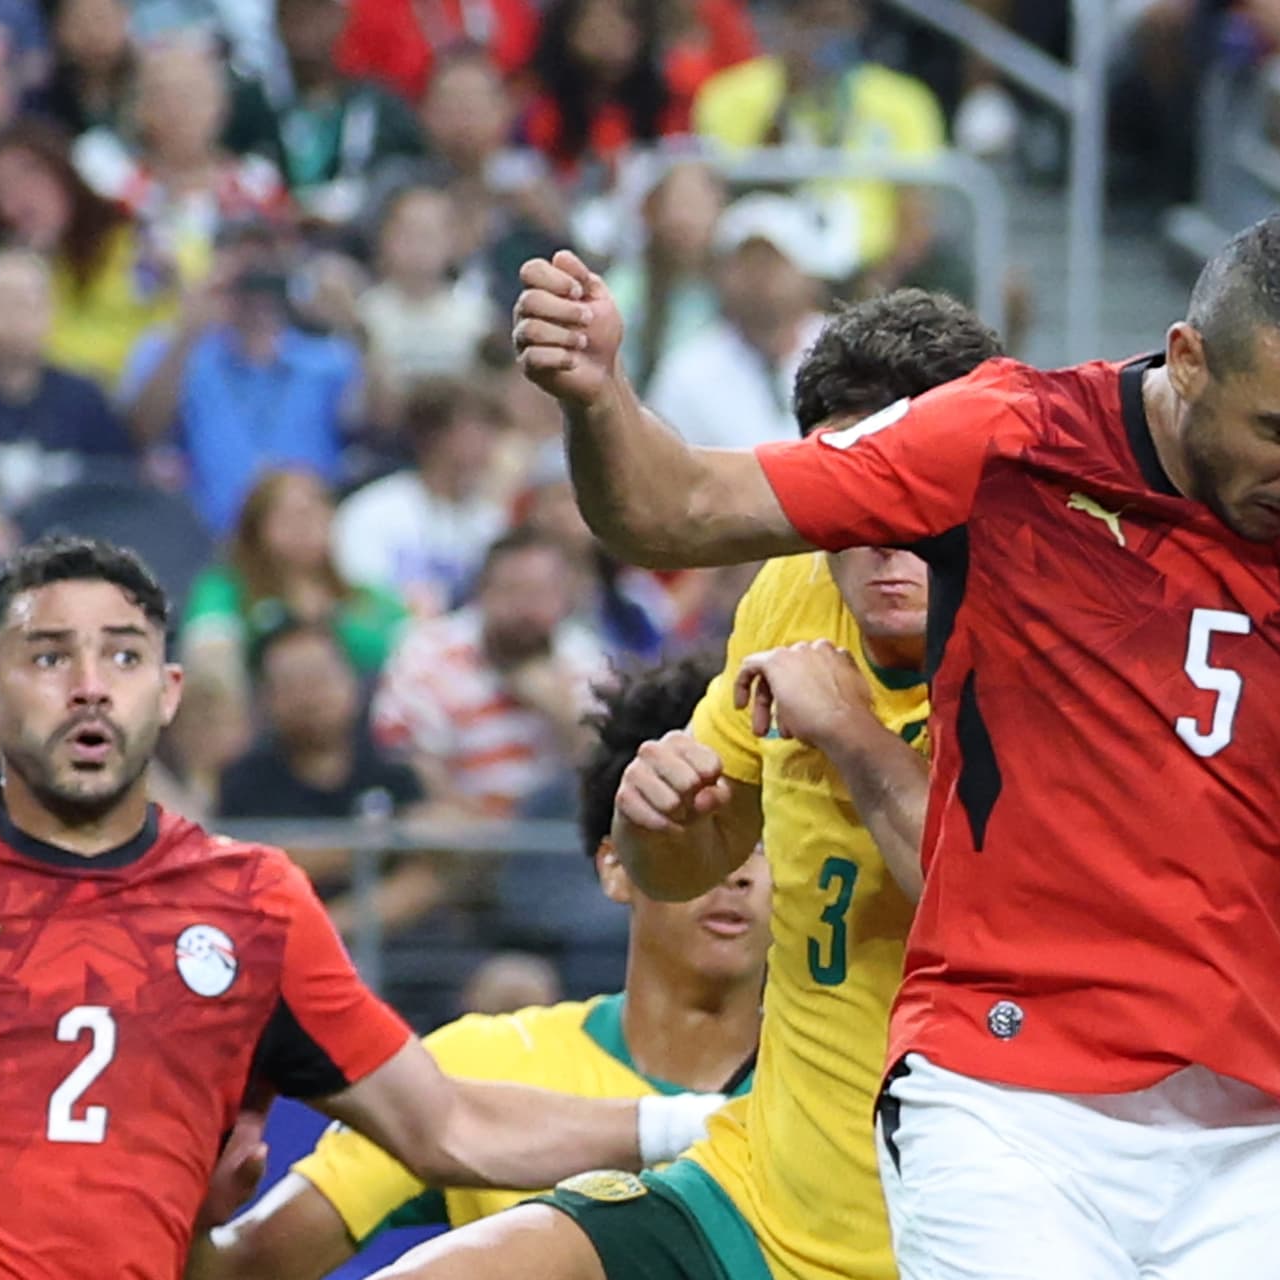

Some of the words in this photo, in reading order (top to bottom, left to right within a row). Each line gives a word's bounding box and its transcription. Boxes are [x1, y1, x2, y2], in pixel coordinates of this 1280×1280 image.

[1176, 609, 1251, 757] 5
[807, 857, 857, 985] 3
[47, 1006, 116, 1142] 2
